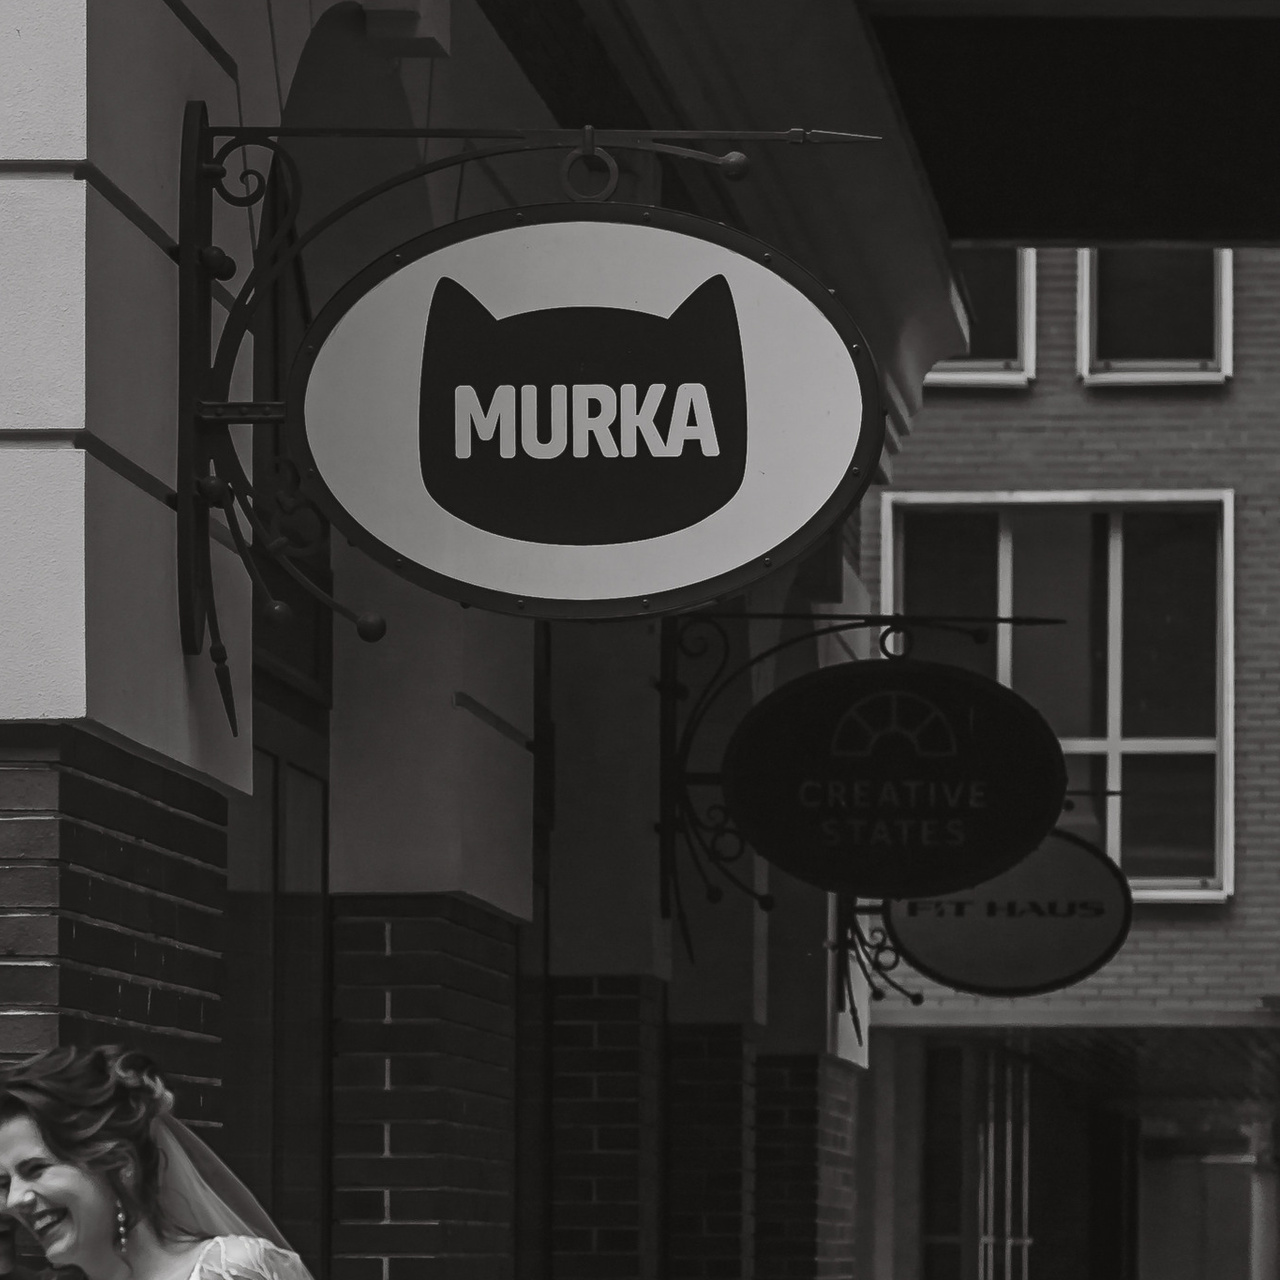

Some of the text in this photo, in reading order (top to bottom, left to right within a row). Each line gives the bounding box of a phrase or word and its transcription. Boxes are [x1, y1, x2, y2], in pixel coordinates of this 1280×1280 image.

[455, 383, 720, 459] MURKA
[798, 780, 987, 808] CREATIVE
[821, 818, 966, 846] STATES
[986, 900, 1106, 918] HAUS
